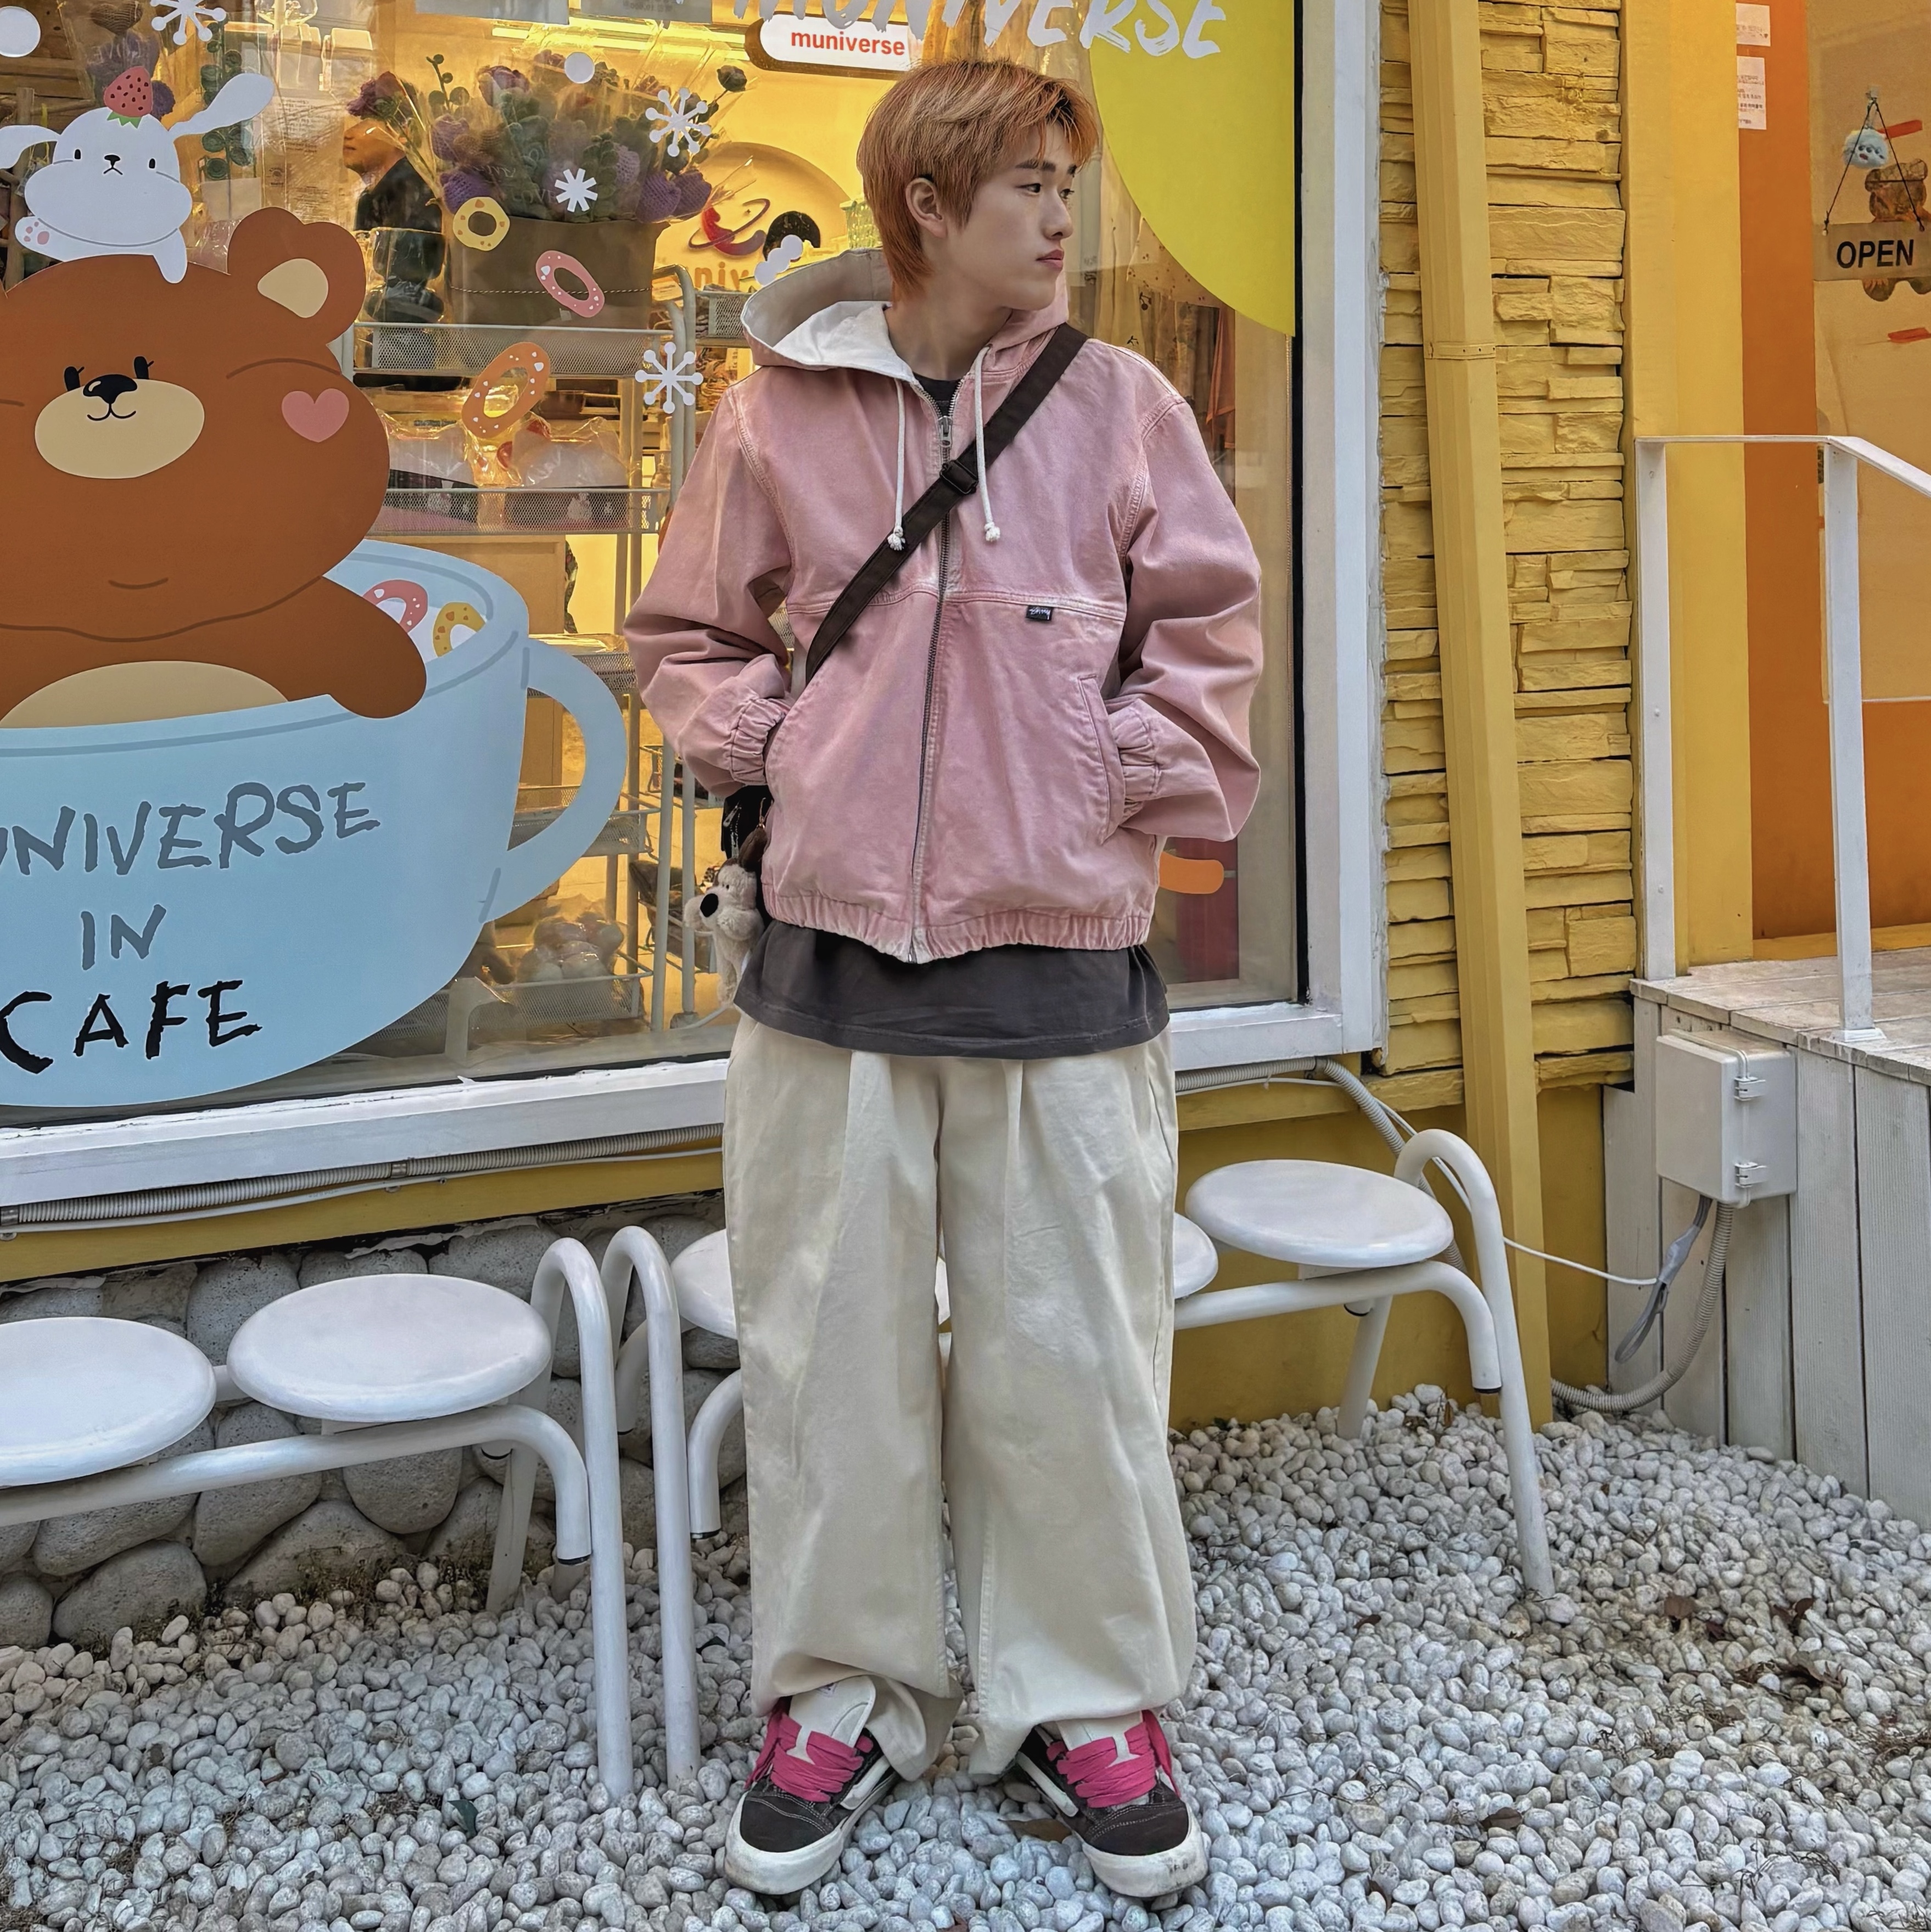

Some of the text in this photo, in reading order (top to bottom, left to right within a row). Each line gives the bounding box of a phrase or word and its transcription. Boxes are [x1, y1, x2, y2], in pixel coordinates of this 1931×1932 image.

[733, 0, 1226, 59] VERSE
[791, 31, 905, 56] muniverse
[1836, 239, 1915, 269] OPEN
[0, 782, 381, 875] NIVERSE
[80, 904, 166, 970] IN
[0, 979, 262, 1074] CAFE
